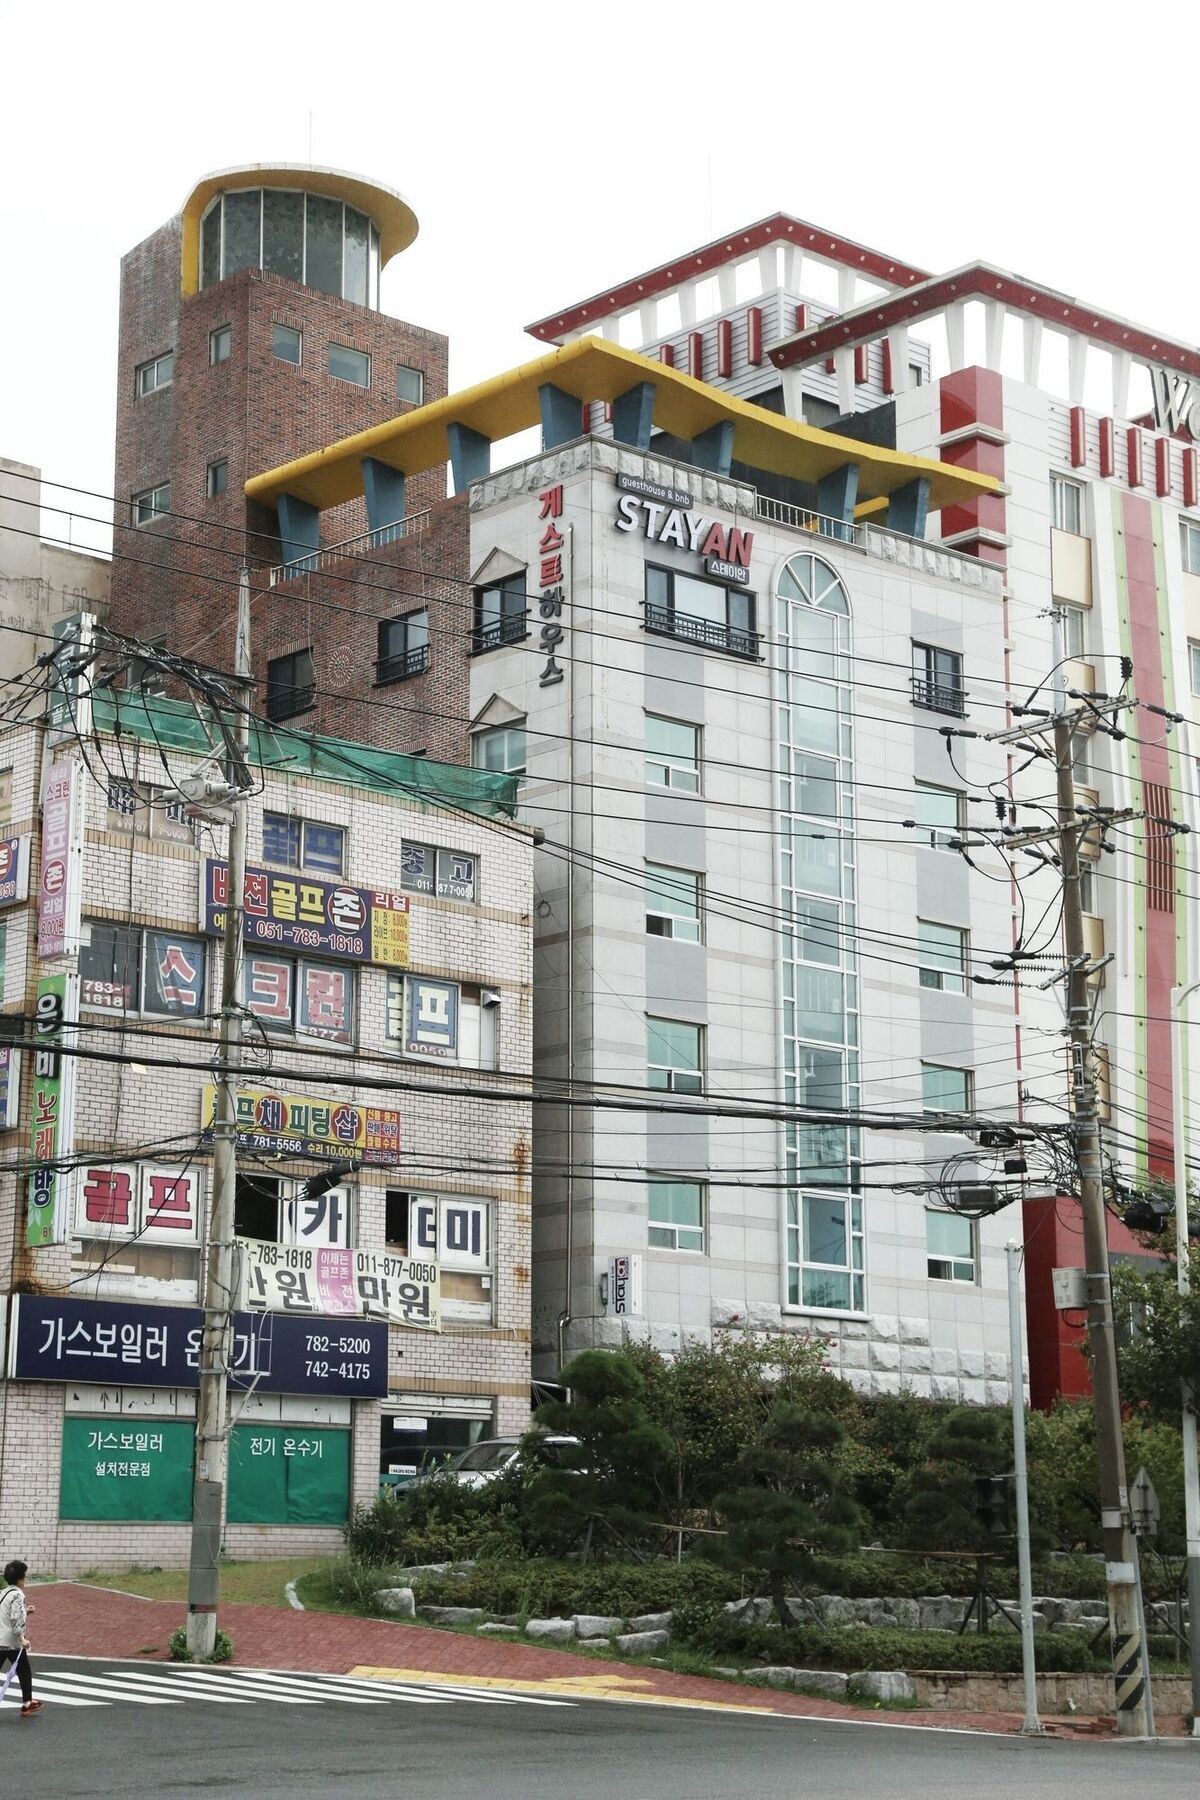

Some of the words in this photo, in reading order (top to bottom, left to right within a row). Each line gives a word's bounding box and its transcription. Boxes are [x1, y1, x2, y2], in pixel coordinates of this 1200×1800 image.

[622, 476, 666, 498] guesthouse
[675, 491, 690, 505] bnb
[614, 494, 755, 568] STAYAN
[710, 560, 747, 582] 스테이안
[538, 483, 564, 688] 게스트하우스
[46, 780, 70, 802] 스크린
[43, 802, 68, 893] 골프존
[44, 896, 63, 915] 리얼
[375, 892, 406, 911] 리얼
[256, 919, 363, 955] 051-783-1818
[33, 1089, 57, 1208] 노래방
[254, 1135, 303, 1153] 781-5556
[308, 1143, 323, 1154] 수리
[325, 1144, 363, 1160] 10,000원
[383, 1138, 398, 1150] 수리
[83, 1169, 193, 1230] 골프
[320, 1252, 349, 1265] 이제는
[357, 1253, 436, 1283] 011-877-0050
[320, 1266, 349, 1279] 골프존
[357, 1275, 431, 1325] 만원
[38, 1317, 168, 1367] 가스보일러
[184, 1328, 257, 1373] 온기
[305, 1334, 371, 1355] 782-5200
[305, 1360, 371, 1380] 742-4175
[87, 1431, 163, 1453] 가스보일러
[249, 1437, 275, 1457] 전기
[283, 1438, 323, 1459] 온수기
[95, 1462, 151, 1477] 설치전문점
